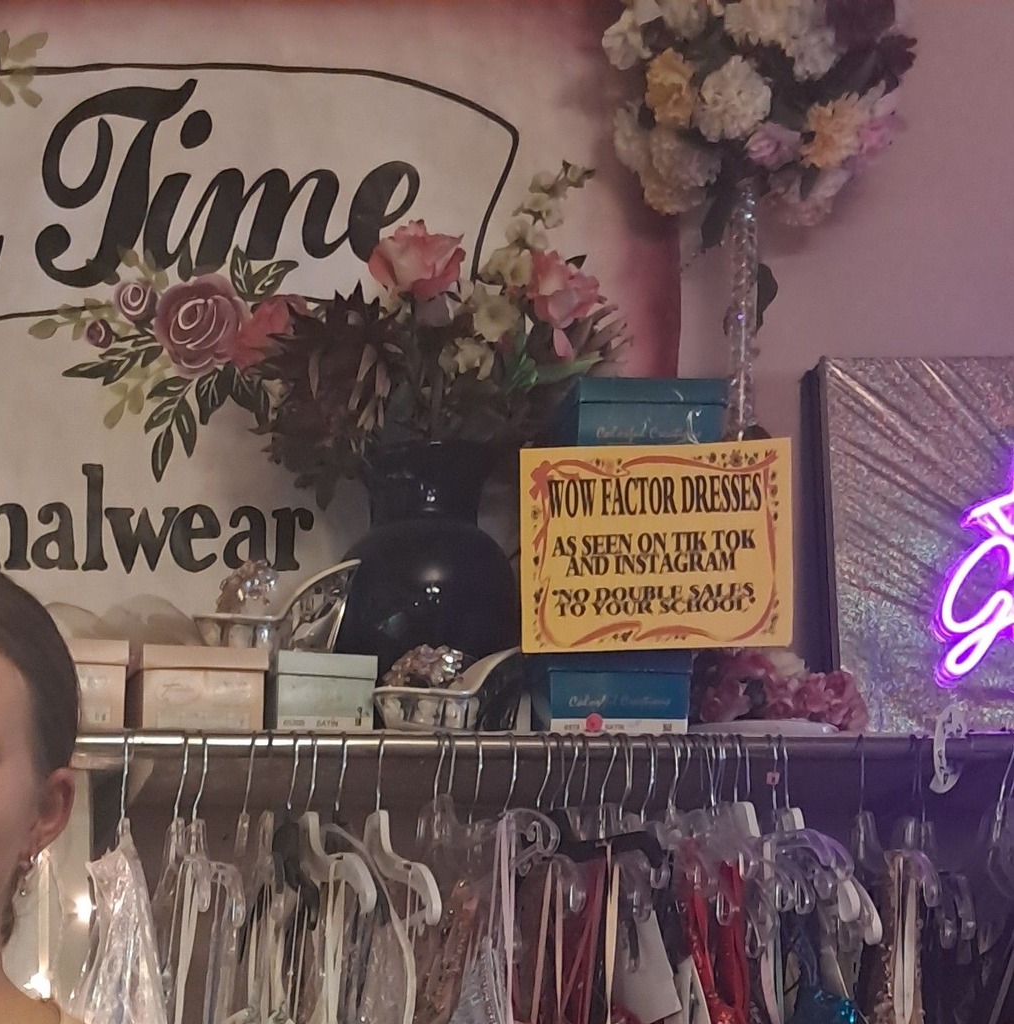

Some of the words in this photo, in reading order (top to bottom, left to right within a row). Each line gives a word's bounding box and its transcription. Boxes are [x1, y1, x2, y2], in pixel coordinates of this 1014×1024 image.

[35, 79, 420, 287] Time
[548, 478, 596, 518] WOW
[601, 475, 677, 516] FACTOR
[681, 473, 762, 515] DRESSES
[552, 535, 577, 557] AS
[581, 533, 633, 555] SEEN
[637, 532, 666, 553] ON
[671, 530, 707, 552] TIK
[711, 529, 756, 550] TOK
[566, 554, 609, 577] AND
[615, 551, 736, 575] INSTAGRAM
[594, 585, 682, 602] DOUBLE
[689, 582, 754, 601] SALES
[555, 600, 586, 617] TO
[591, 600, 653, 617] YOUR
